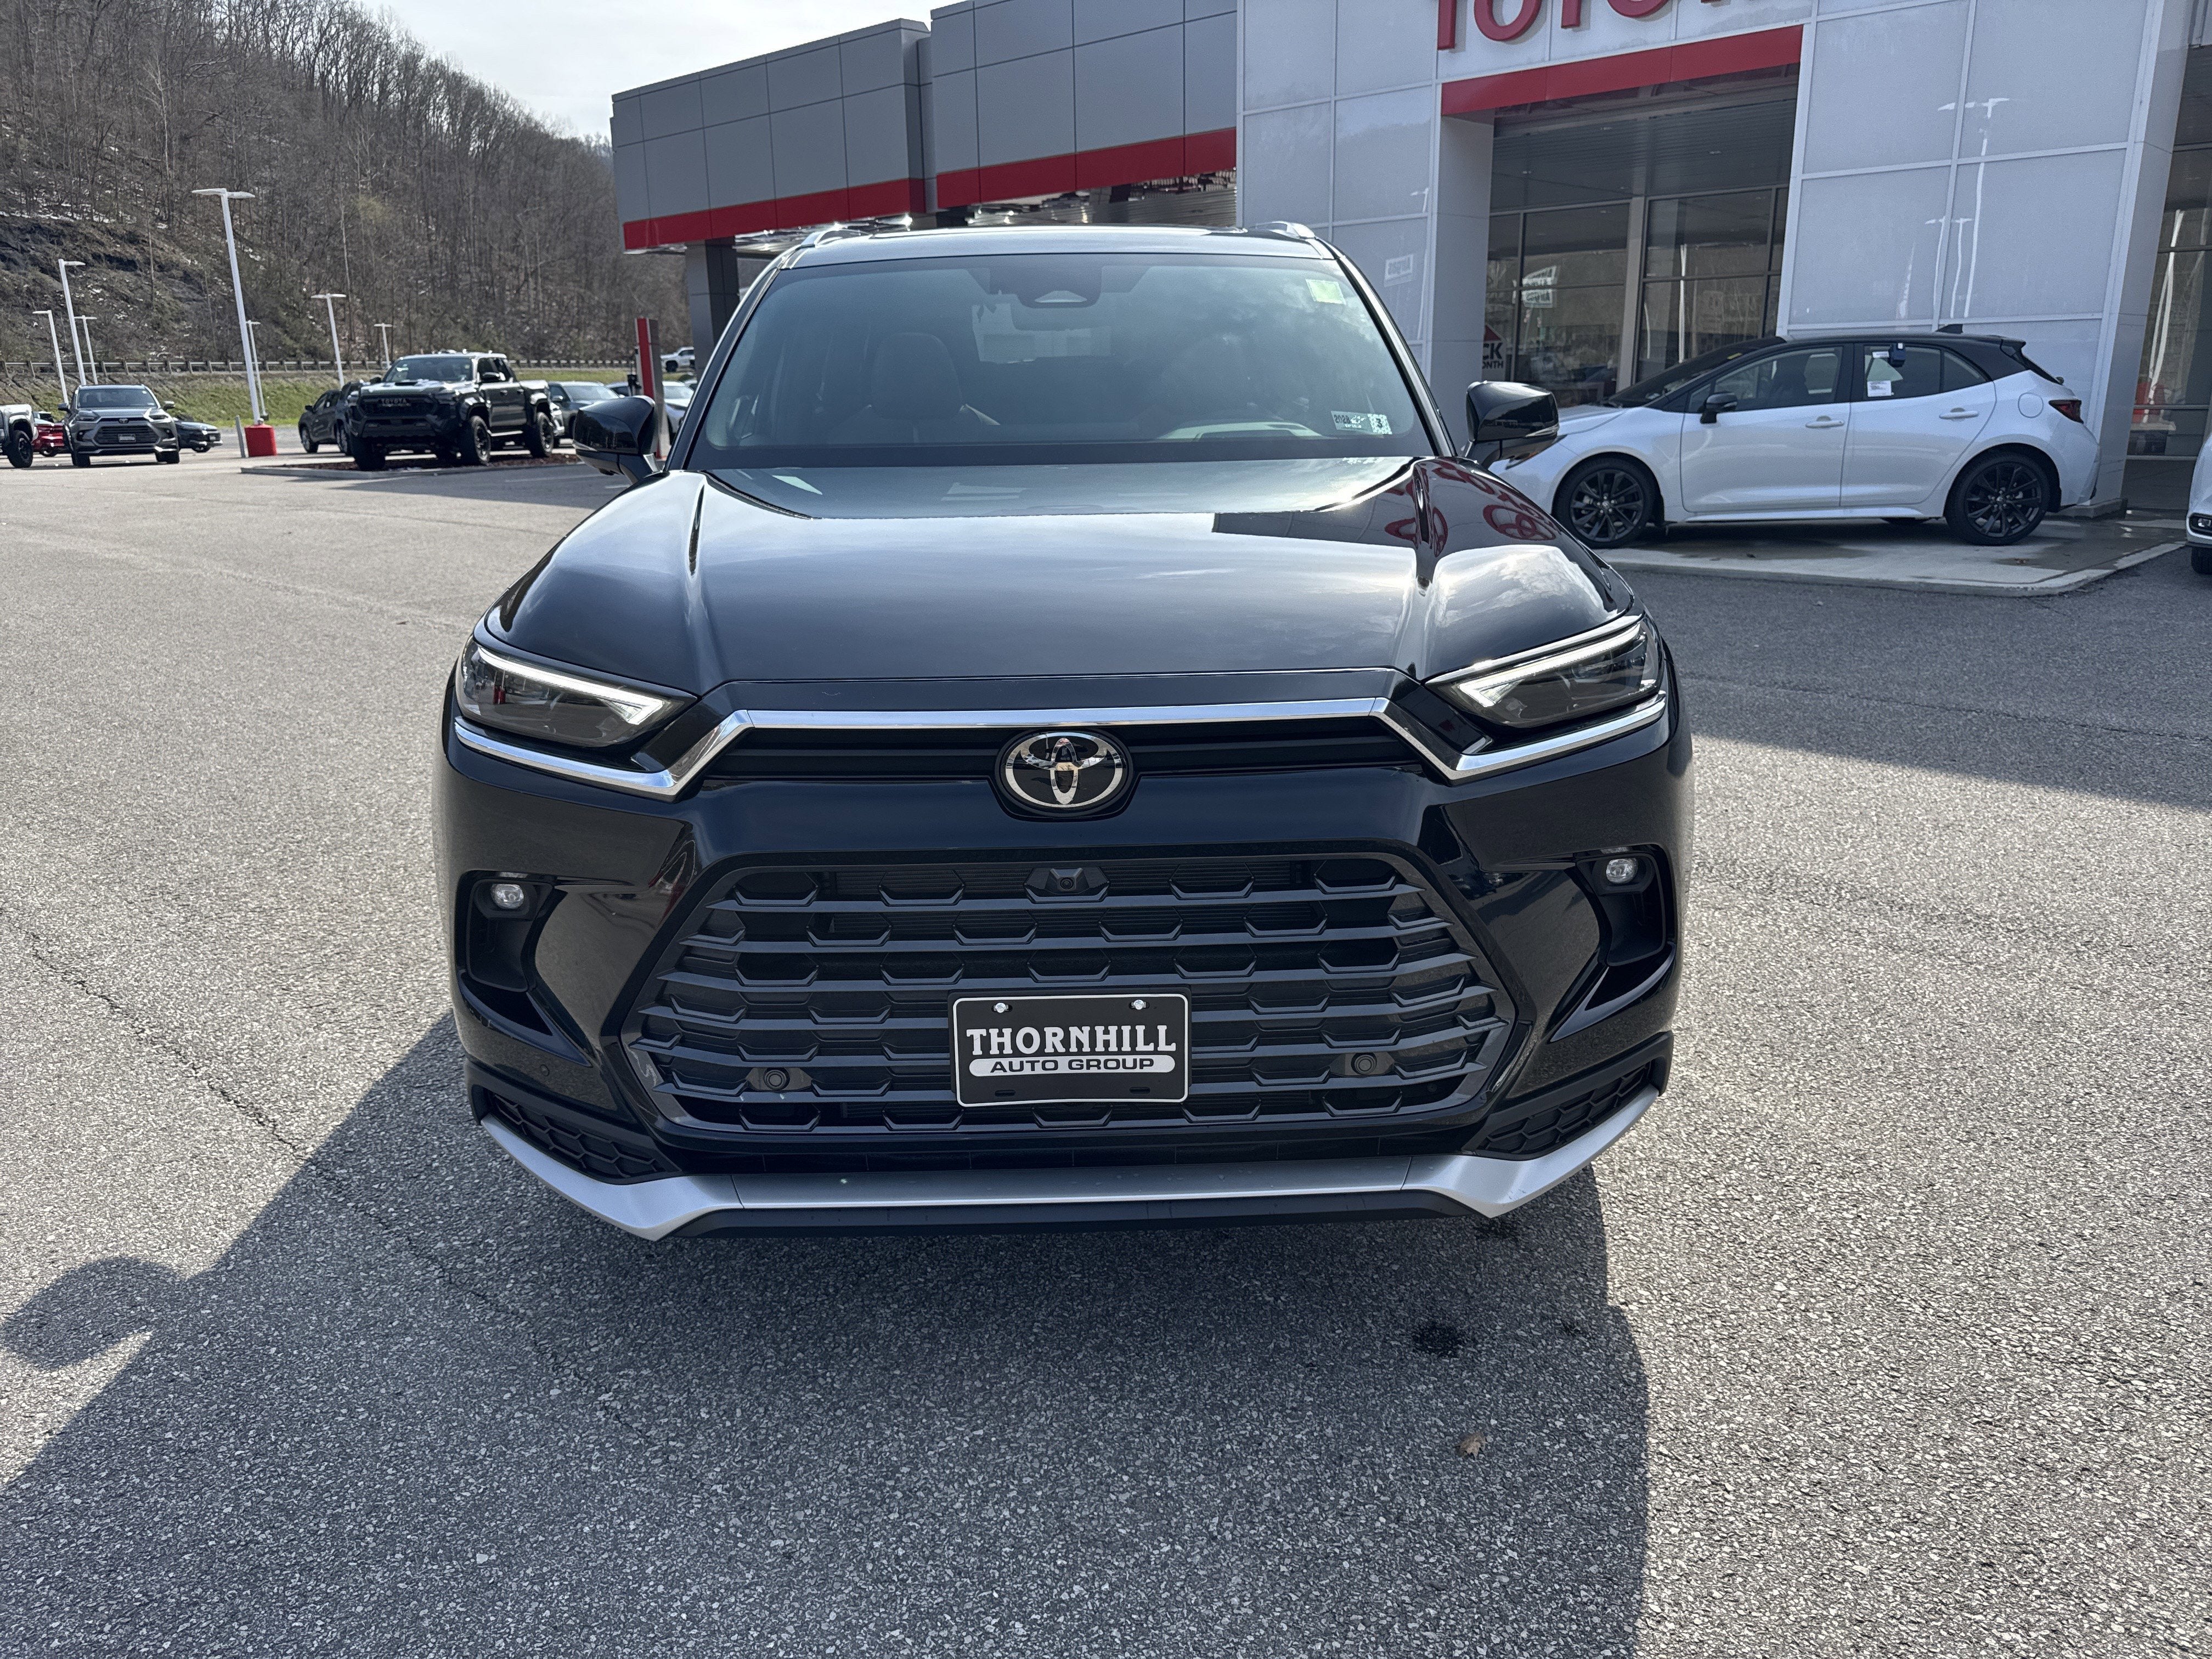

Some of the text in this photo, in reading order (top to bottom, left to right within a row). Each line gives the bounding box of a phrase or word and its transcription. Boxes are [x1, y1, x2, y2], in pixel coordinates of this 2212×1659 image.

[966, 1025, 1176, 1056] THORNHILL
[990, 1058, 1154, 1073] AUTO GROUP
